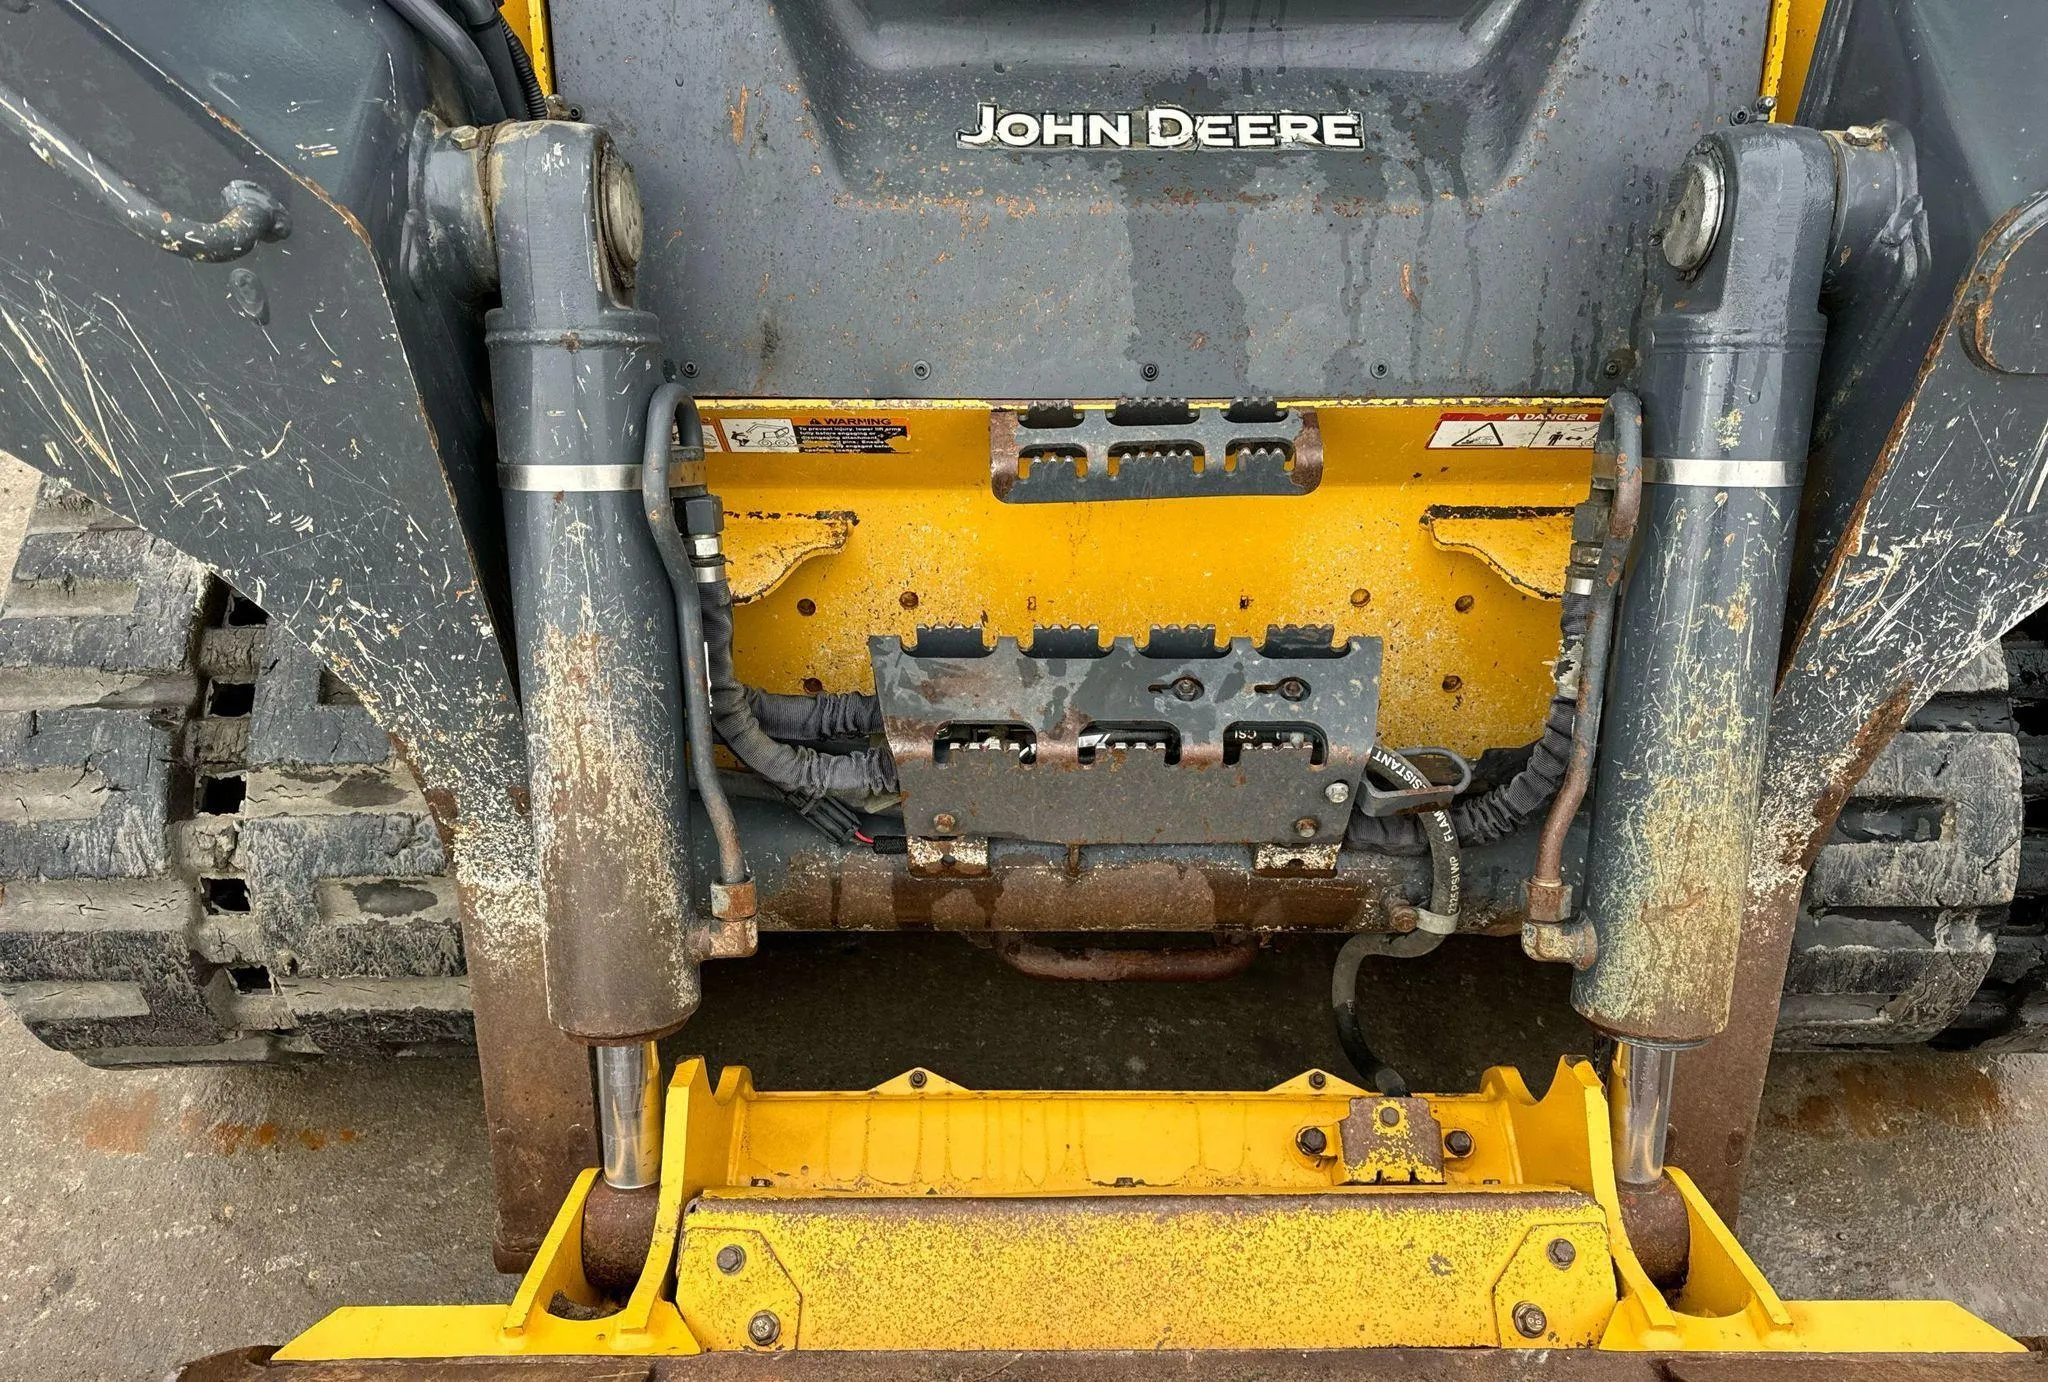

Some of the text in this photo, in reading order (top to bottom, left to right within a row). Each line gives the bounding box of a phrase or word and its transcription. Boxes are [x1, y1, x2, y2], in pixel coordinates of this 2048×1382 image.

[957, 103, 1363, 149] JOHN DEERE
[1523, 413, 1589, 421] DANGER
[1372, 750, 1427, 790] SISTANT
[1432, 809, 1454, 842] FLAM
